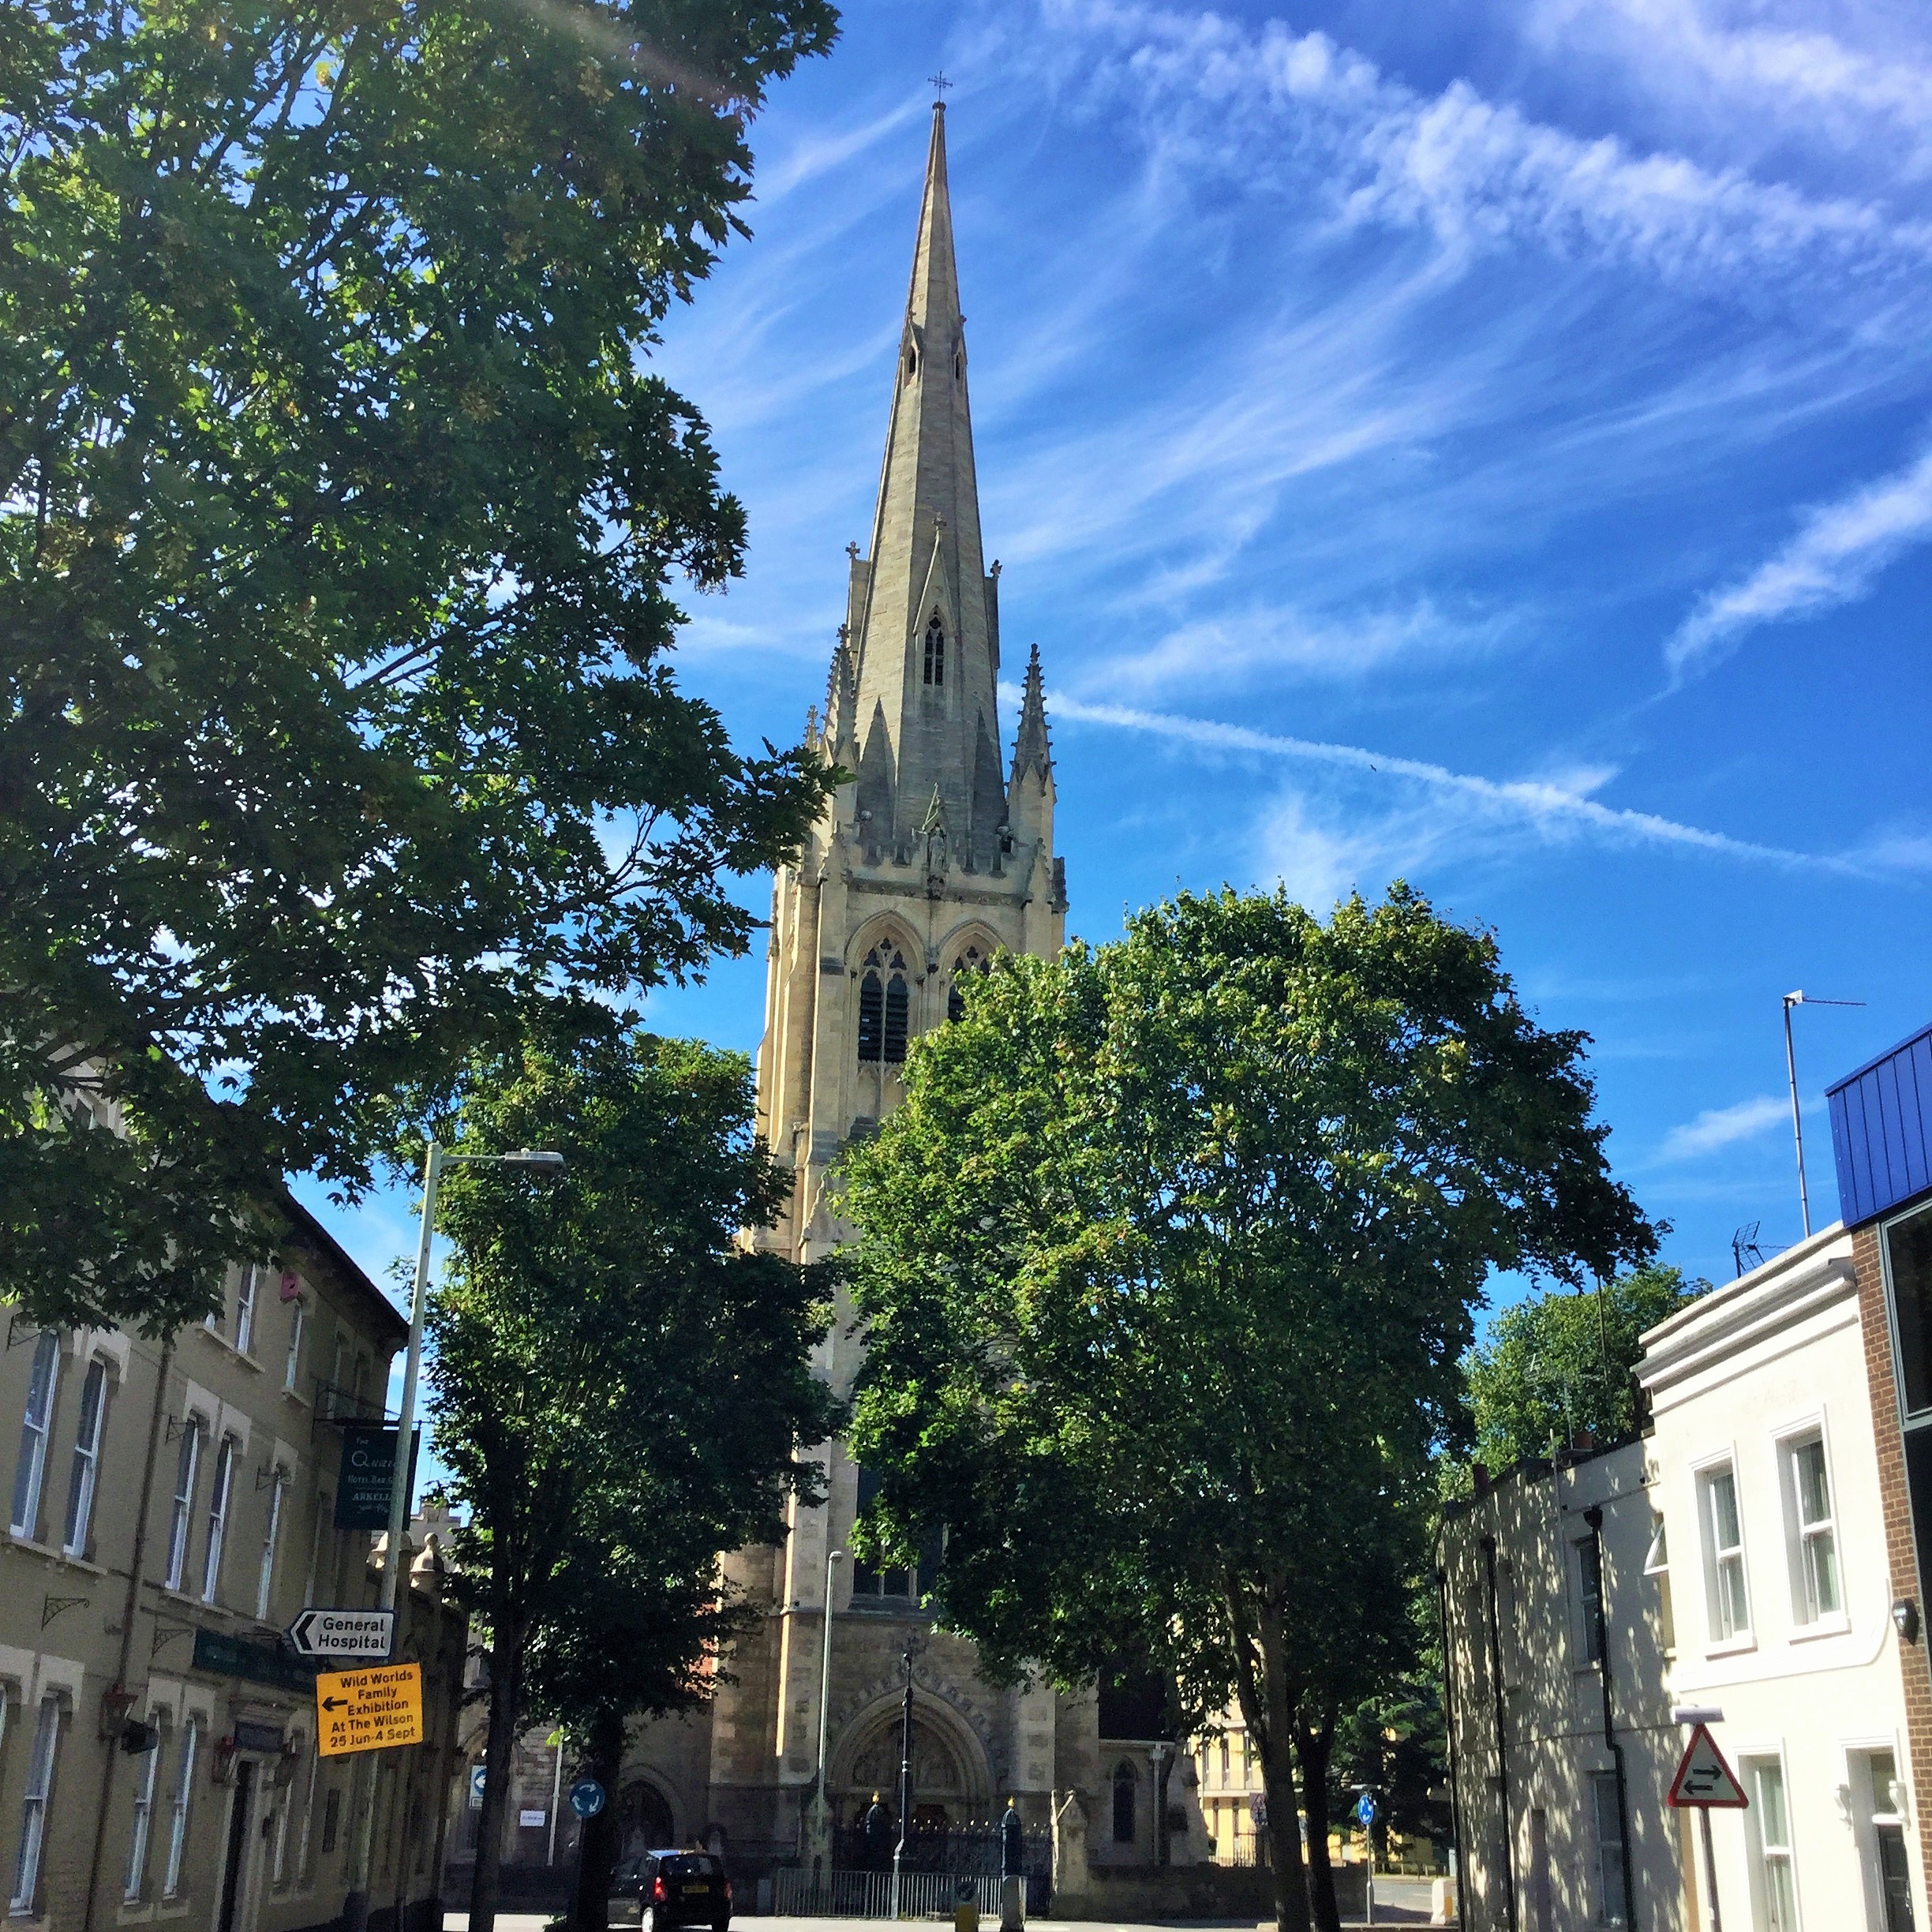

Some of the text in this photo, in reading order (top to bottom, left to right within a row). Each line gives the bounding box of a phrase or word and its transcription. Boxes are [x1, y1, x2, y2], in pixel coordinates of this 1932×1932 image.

[352, 1492, 391, 1501] ARKELL
[323, 1616, 385, 1632] General
[318, 1634, 385, 1650] Hospital
[340, 1670, 414, 1688] Wild Worlds
[358, 1686, 397, 1699] Family
[347, 1699, 409, 1716] Exhibition
[331, 1714, 414, 1733] At The Wilson
[330, 1726, 415, 1748] 25 Jun-4 Sept
